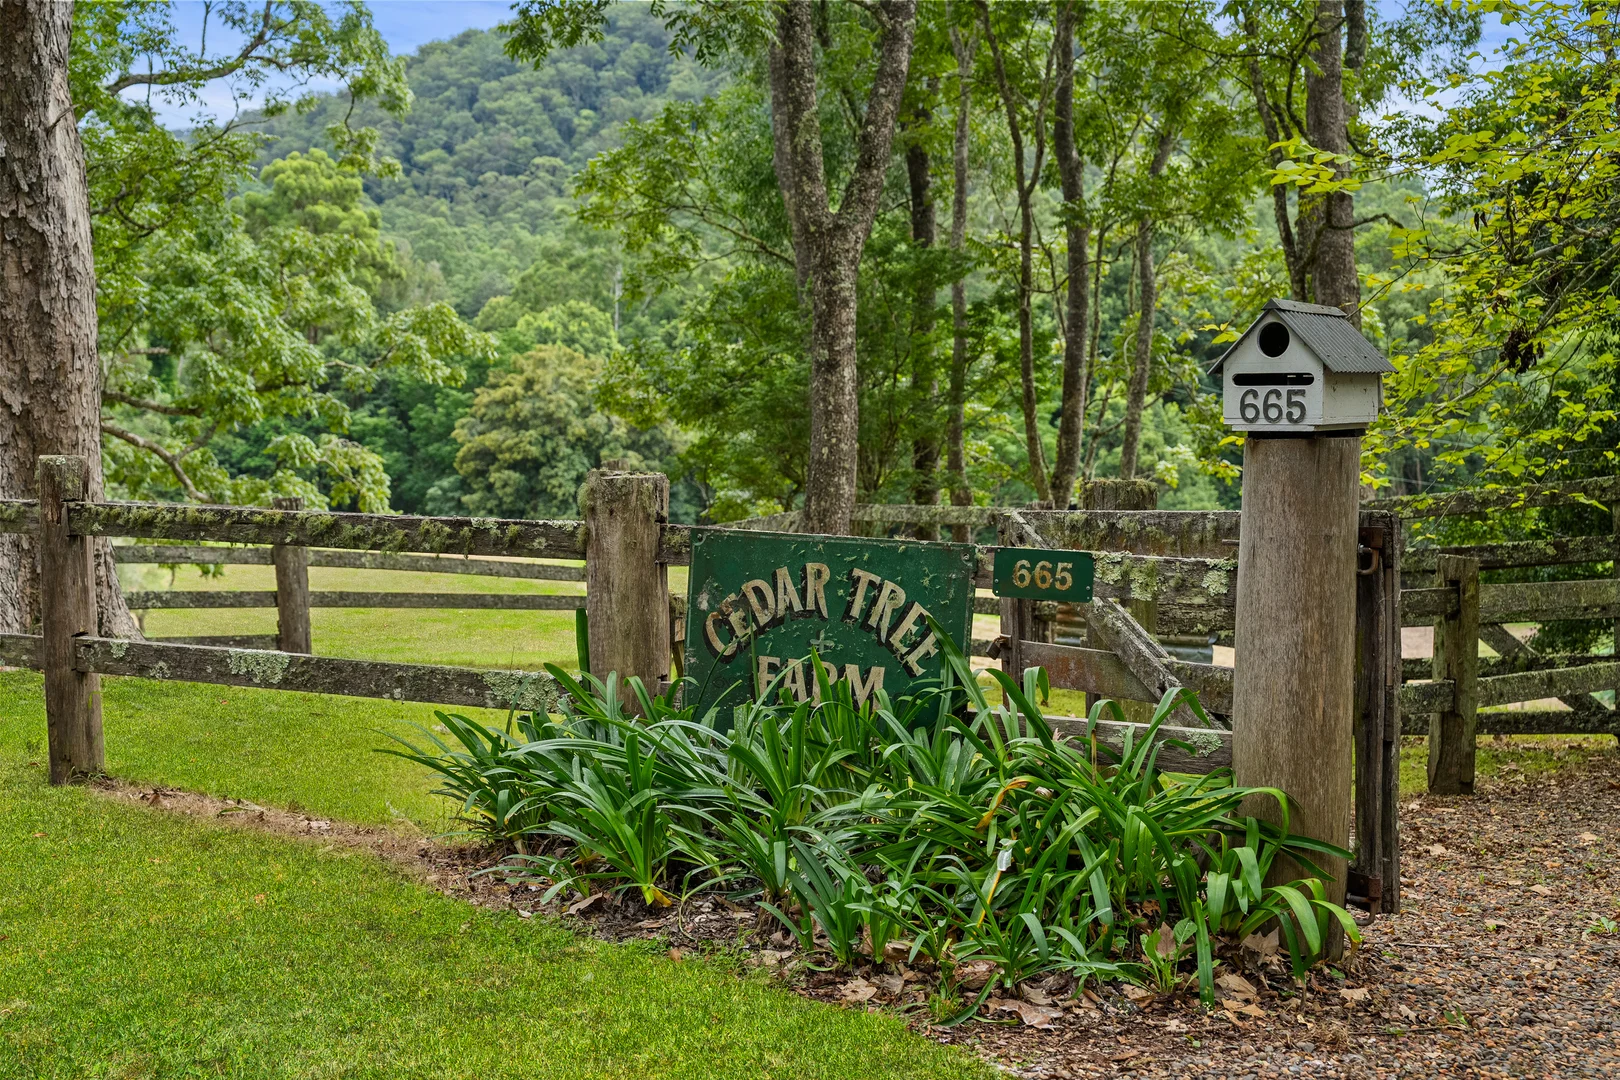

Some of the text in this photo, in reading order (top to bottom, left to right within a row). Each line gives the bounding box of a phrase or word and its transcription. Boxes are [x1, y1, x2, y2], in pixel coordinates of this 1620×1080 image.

[1240, 388, 1307, 424] 665
[1012, 559, 1073, 591] 665
[704, 562, 940, 678] CEDAR TREE
